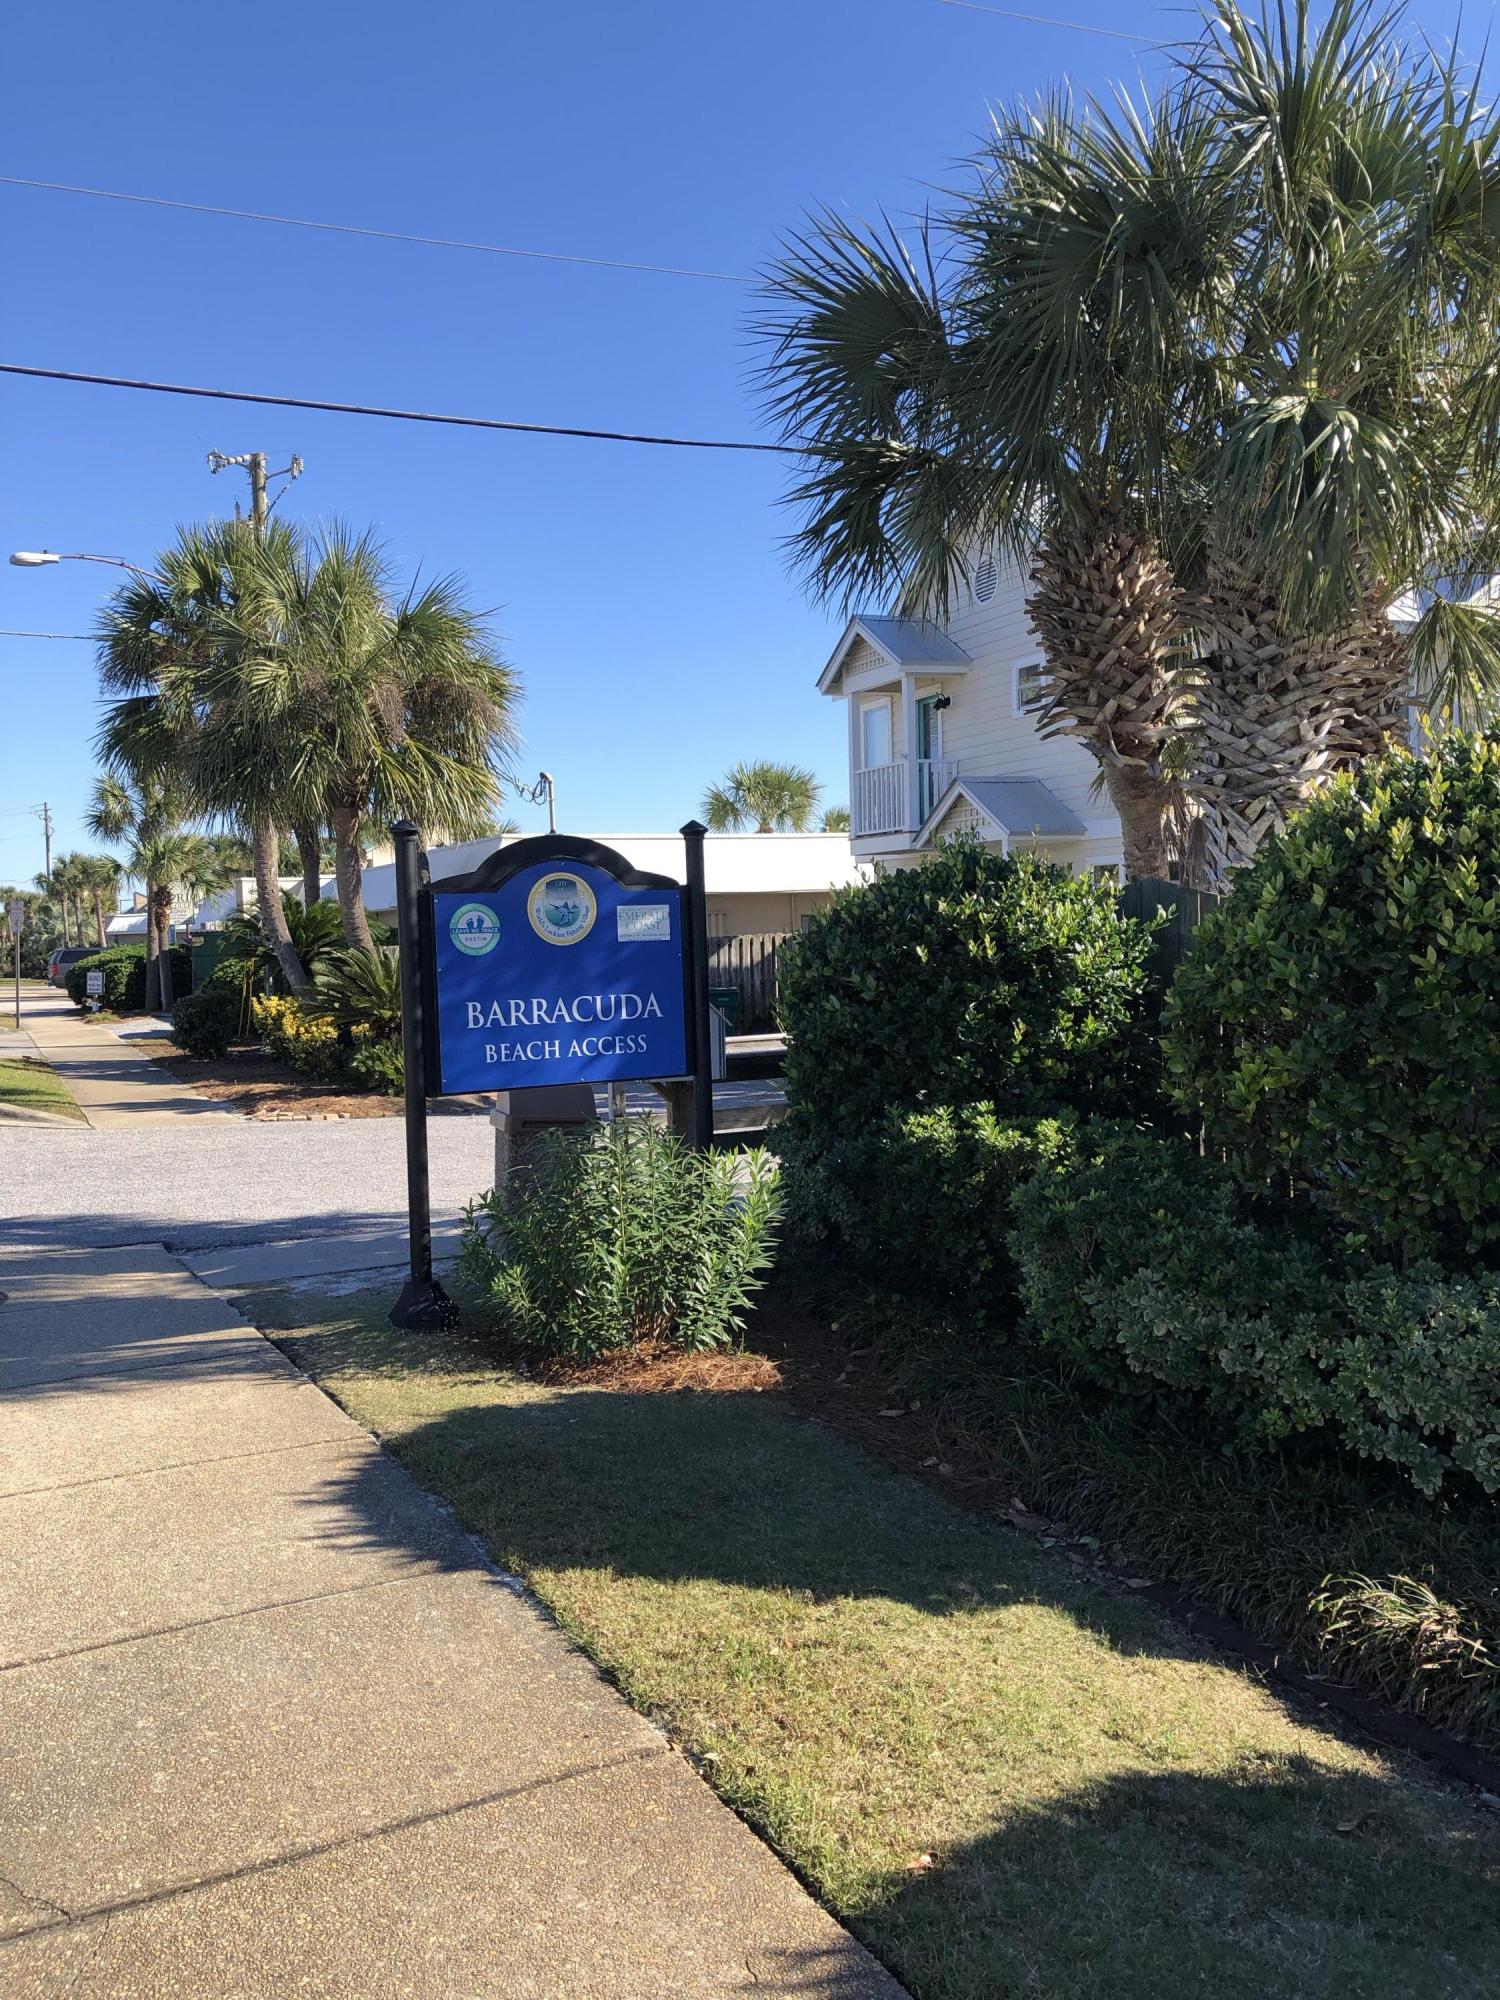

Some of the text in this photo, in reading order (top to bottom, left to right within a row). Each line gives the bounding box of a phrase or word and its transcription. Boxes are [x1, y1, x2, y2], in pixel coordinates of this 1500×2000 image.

[618, 911, 670, 921] EMERALD
[625, 920, 661, 931] COAST
[466, 992, 664, 1029] BARRACUDA
[485, 1034, 648, 1064] BEACH ACCESS
